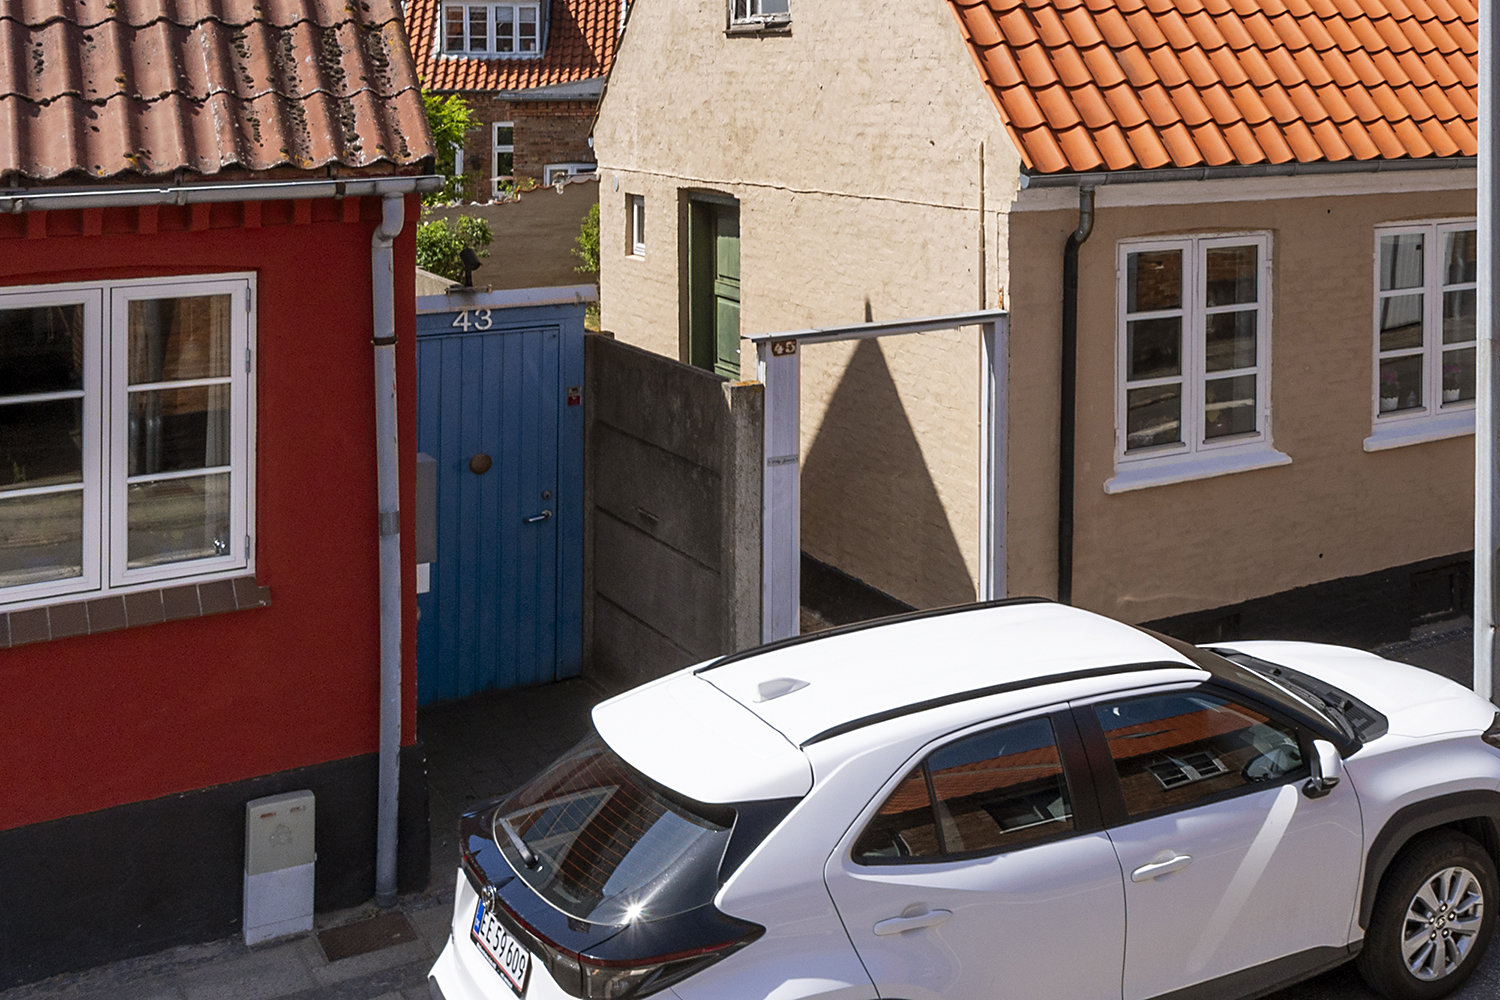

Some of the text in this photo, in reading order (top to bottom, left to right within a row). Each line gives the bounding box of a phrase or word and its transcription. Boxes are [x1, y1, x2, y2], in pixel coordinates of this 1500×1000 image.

[453, 310, 493, 331] 43
[774, 341, 796, 355] 45
[493, 926, 508, 957] 59
[506, 942, 526, 980] 609
